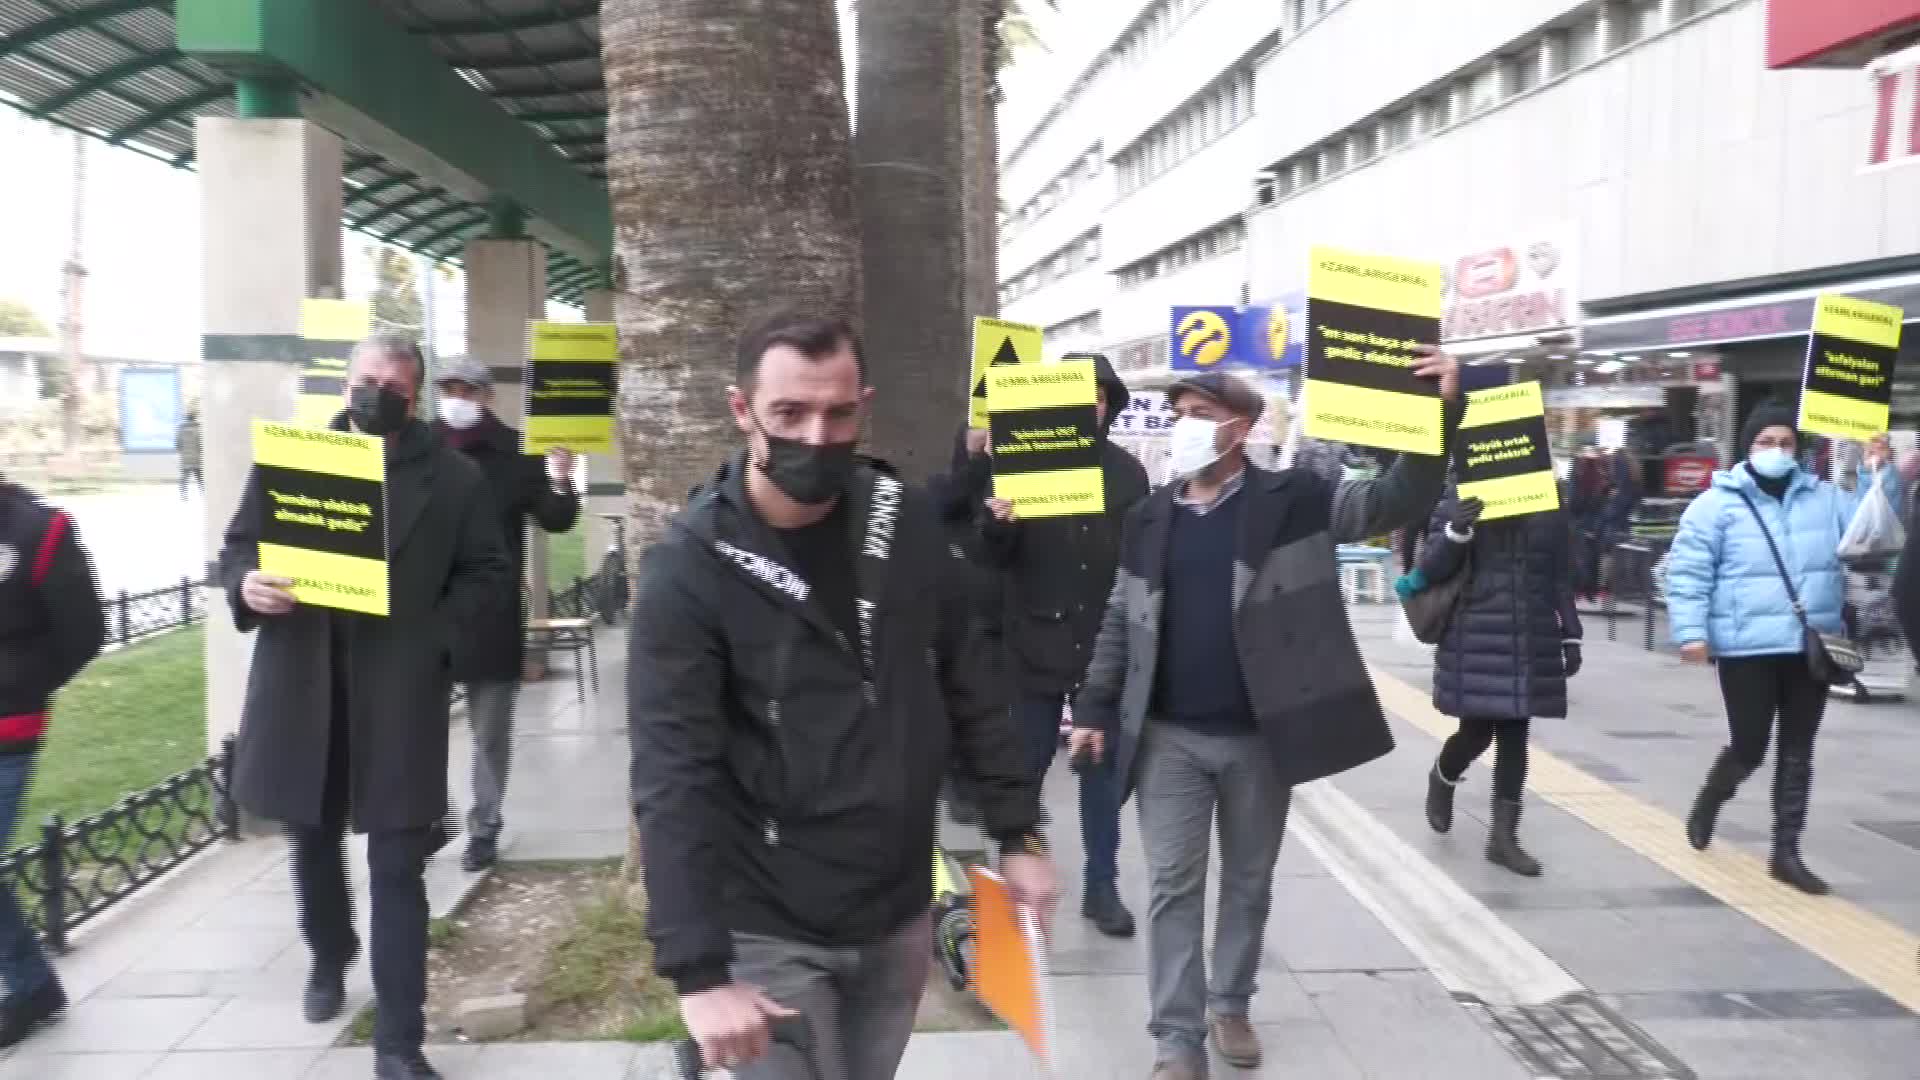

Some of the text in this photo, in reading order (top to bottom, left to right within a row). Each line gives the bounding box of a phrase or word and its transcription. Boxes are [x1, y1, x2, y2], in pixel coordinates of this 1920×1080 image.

[1342, 330, 1367, 344] son
[1368, 331, 1400, 350] kaça
[1324, 345, 1363, 360] gediz
[1056, 424, 1078, 439] OUT
[994, 439, 1032, 455] elektrik
[1503, 433, 1530, 447] ortak
[1467, 452, 1493, 468] gediz
[322, 497, 373, 517] elektrik
[861, 475, 904, 561] MONCLER
